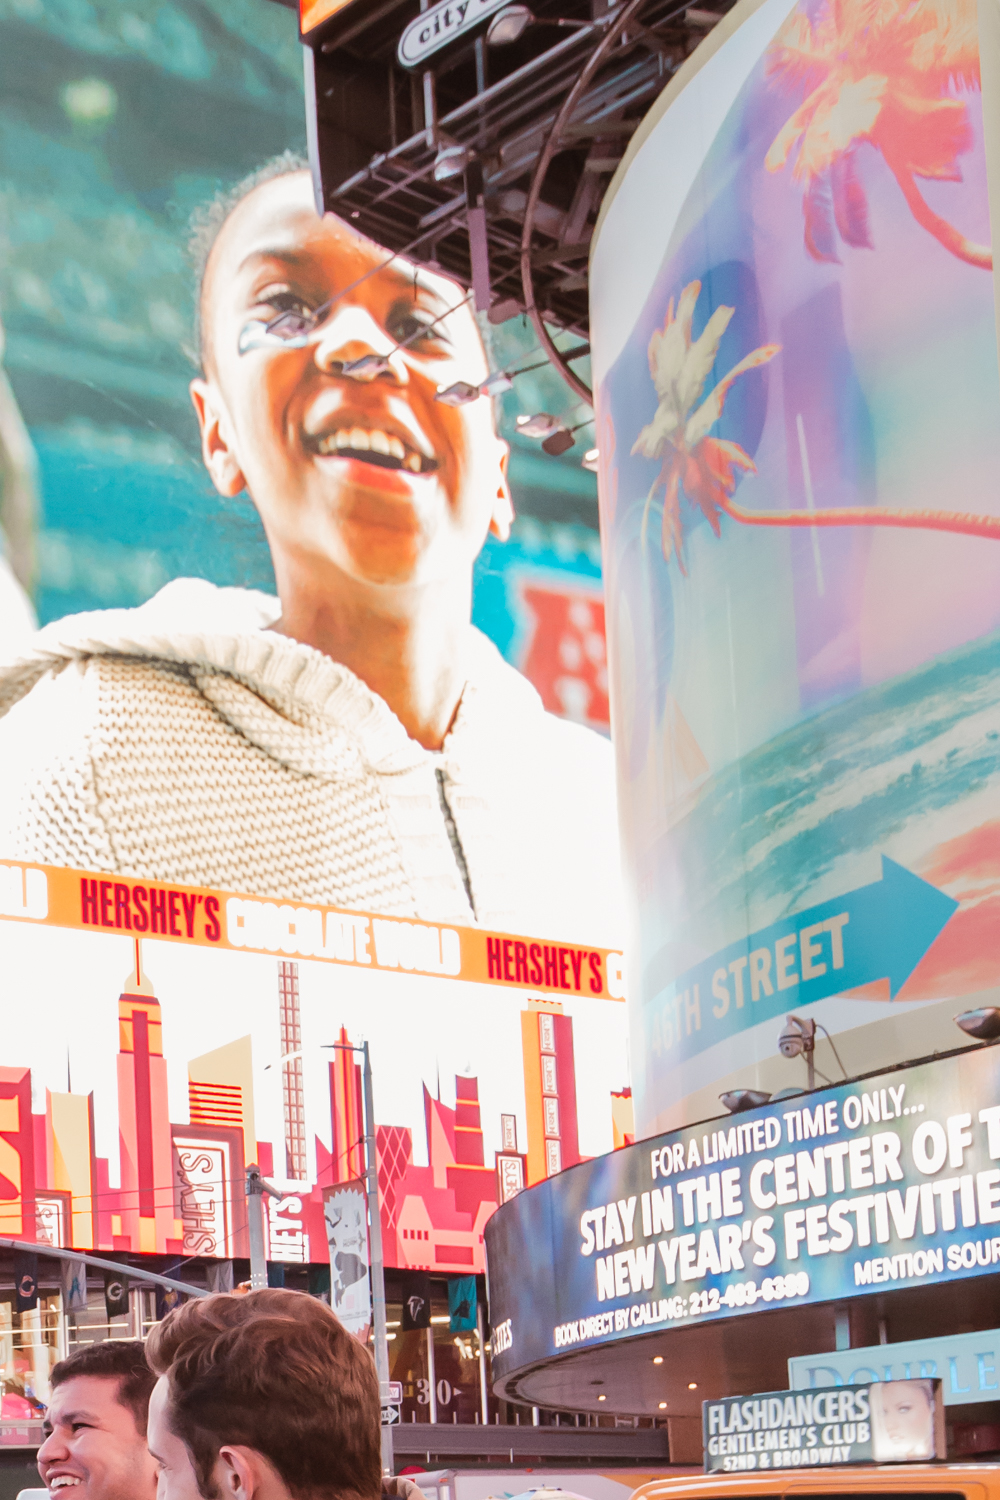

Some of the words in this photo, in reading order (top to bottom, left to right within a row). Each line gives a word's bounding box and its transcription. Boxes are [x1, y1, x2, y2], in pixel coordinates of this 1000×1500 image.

[419, 1, 469, 43] city
[80, 877, 221, 942] HERSHEY'S
[486, 936, 602, 994] HERSHEY'S
[711, 912, 850, 1019] STREET
[651, 1147, 686, 1180] FOR
[686, 1142, 699, 1171] A
[704, 1116, 782, 1164] LIMITED
[785, 1106, 841, 1144] TIME
[842, 1084, 925, 1129] ONLY...
[580, 1196, 638, 1257] STAY
[640, 1186, 675, 1238] IN
[677, 1166, 744, 1227] THE
[749, 1131, 903, 1209] CENTER
[911, 1114, 973, 1175] OF
[554, 1321, 580, 1348] BOOK
[580, 1311, 615, 1340] DIRECT
[615, 1307, 631, 1331] BY
[631, 1298, 688, 1327] CALLING:
[854, 1246, 944, 1286] MENTION
[596, 1242, 658, 1302] NEW
[658, 1216, 776, 1284] YEAR'S
[416, 1378, 451, 1405] 30
[709, 1388, 870, 1435] FLASHDANCERS
[708, 1425, 817, 1456] GENTLEMEN'S
[822, 1422, 870, 1445] CLUB
[723, 1454, 756, 1471] 52ND
[759, 1453, 770, 1467] &
[773, 1446, 850, 1467] BROADWAY
